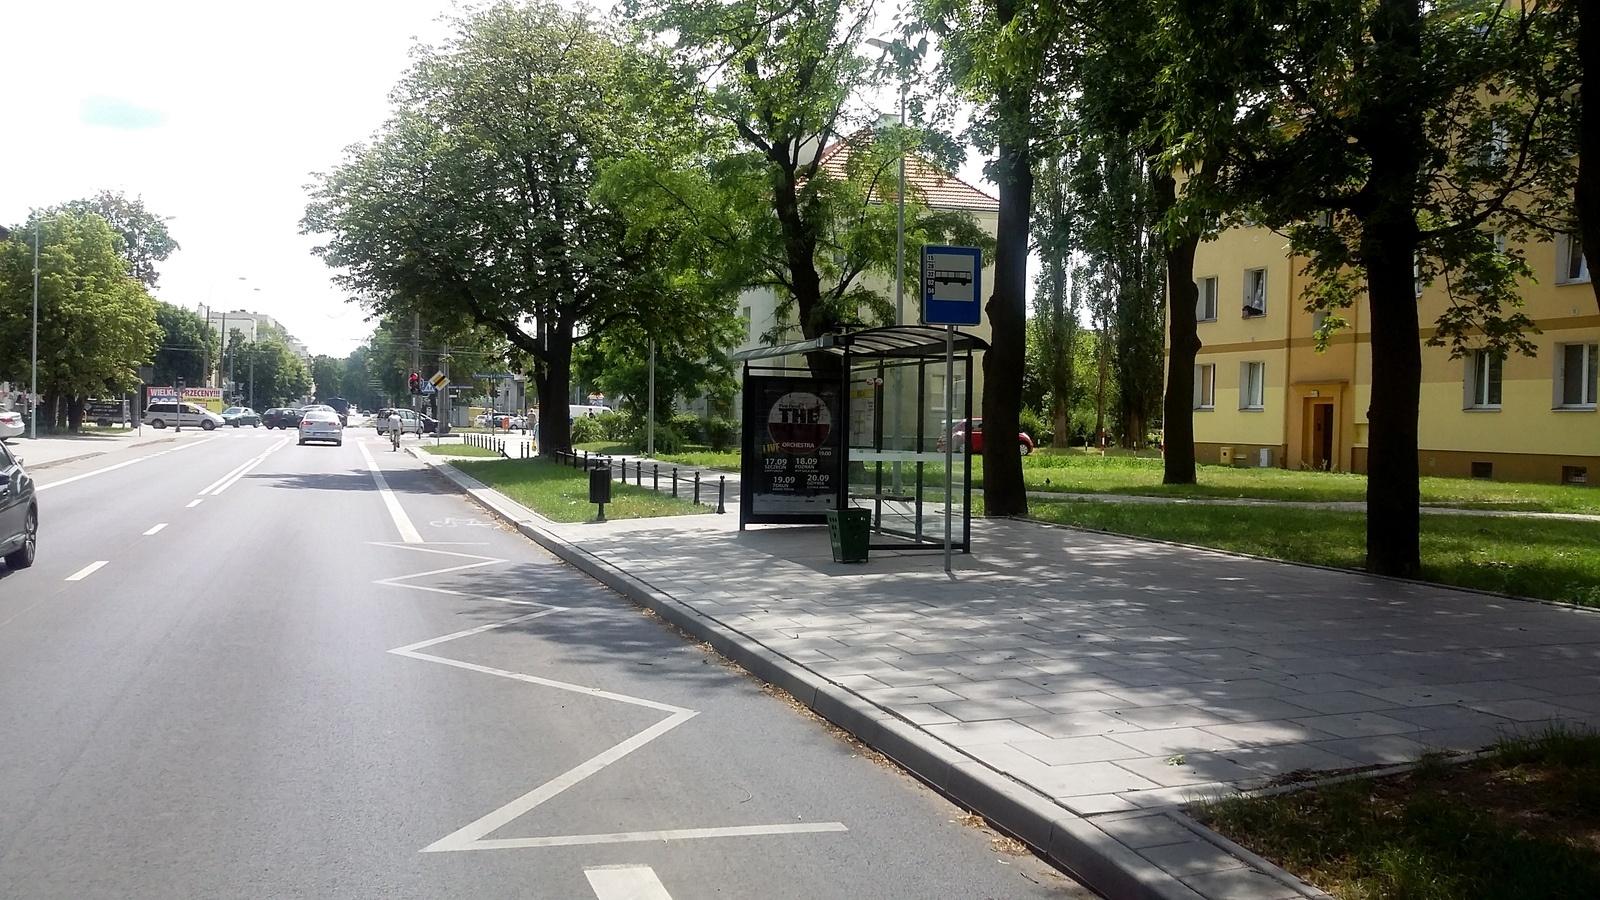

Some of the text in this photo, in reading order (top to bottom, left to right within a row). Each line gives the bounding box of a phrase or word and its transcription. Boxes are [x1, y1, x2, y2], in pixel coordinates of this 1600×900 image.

[779, 408, 820, 423] THE
[796, 457, 818, 465] 18.09
[773, 476, 796, 484] 19.09
